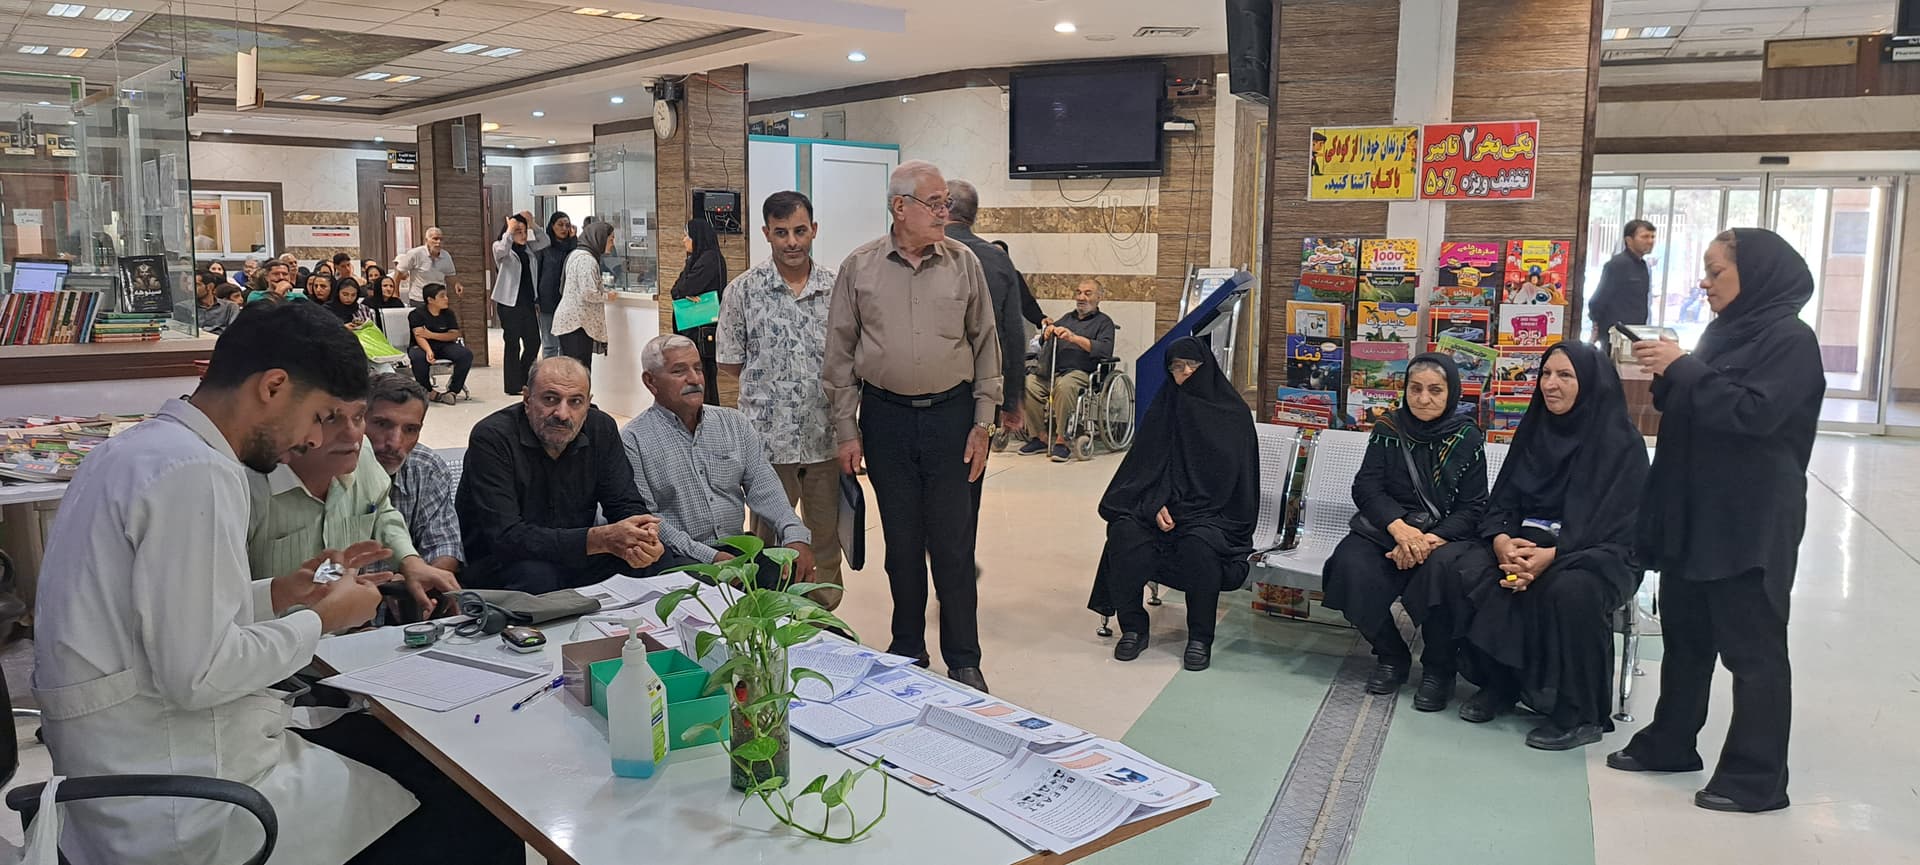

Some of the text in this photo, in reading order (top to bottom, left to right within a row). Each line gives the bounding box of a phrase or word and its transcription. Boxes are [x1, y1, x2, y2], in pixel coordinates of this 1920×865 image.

[1325, 133, 1406, 163] فرزندان خود را از کودکی
[1446, 135, 1460, 155] تا
[1472, 133, 1502, 161] بخر
[1502, 133, 1534, 158] یکی
[1350, 172, 1371, 190] آشنا
[1370, 167, 1394, 194] کتاب
[1394, 167, 1401, 194] با
[1461, 171, 1489, 196] ویژه
[1491, 169, 1530, 194] تخفیف
[1372, 248, 1402, 262] 1000
[1295, 347, 1321, 361] فضا
